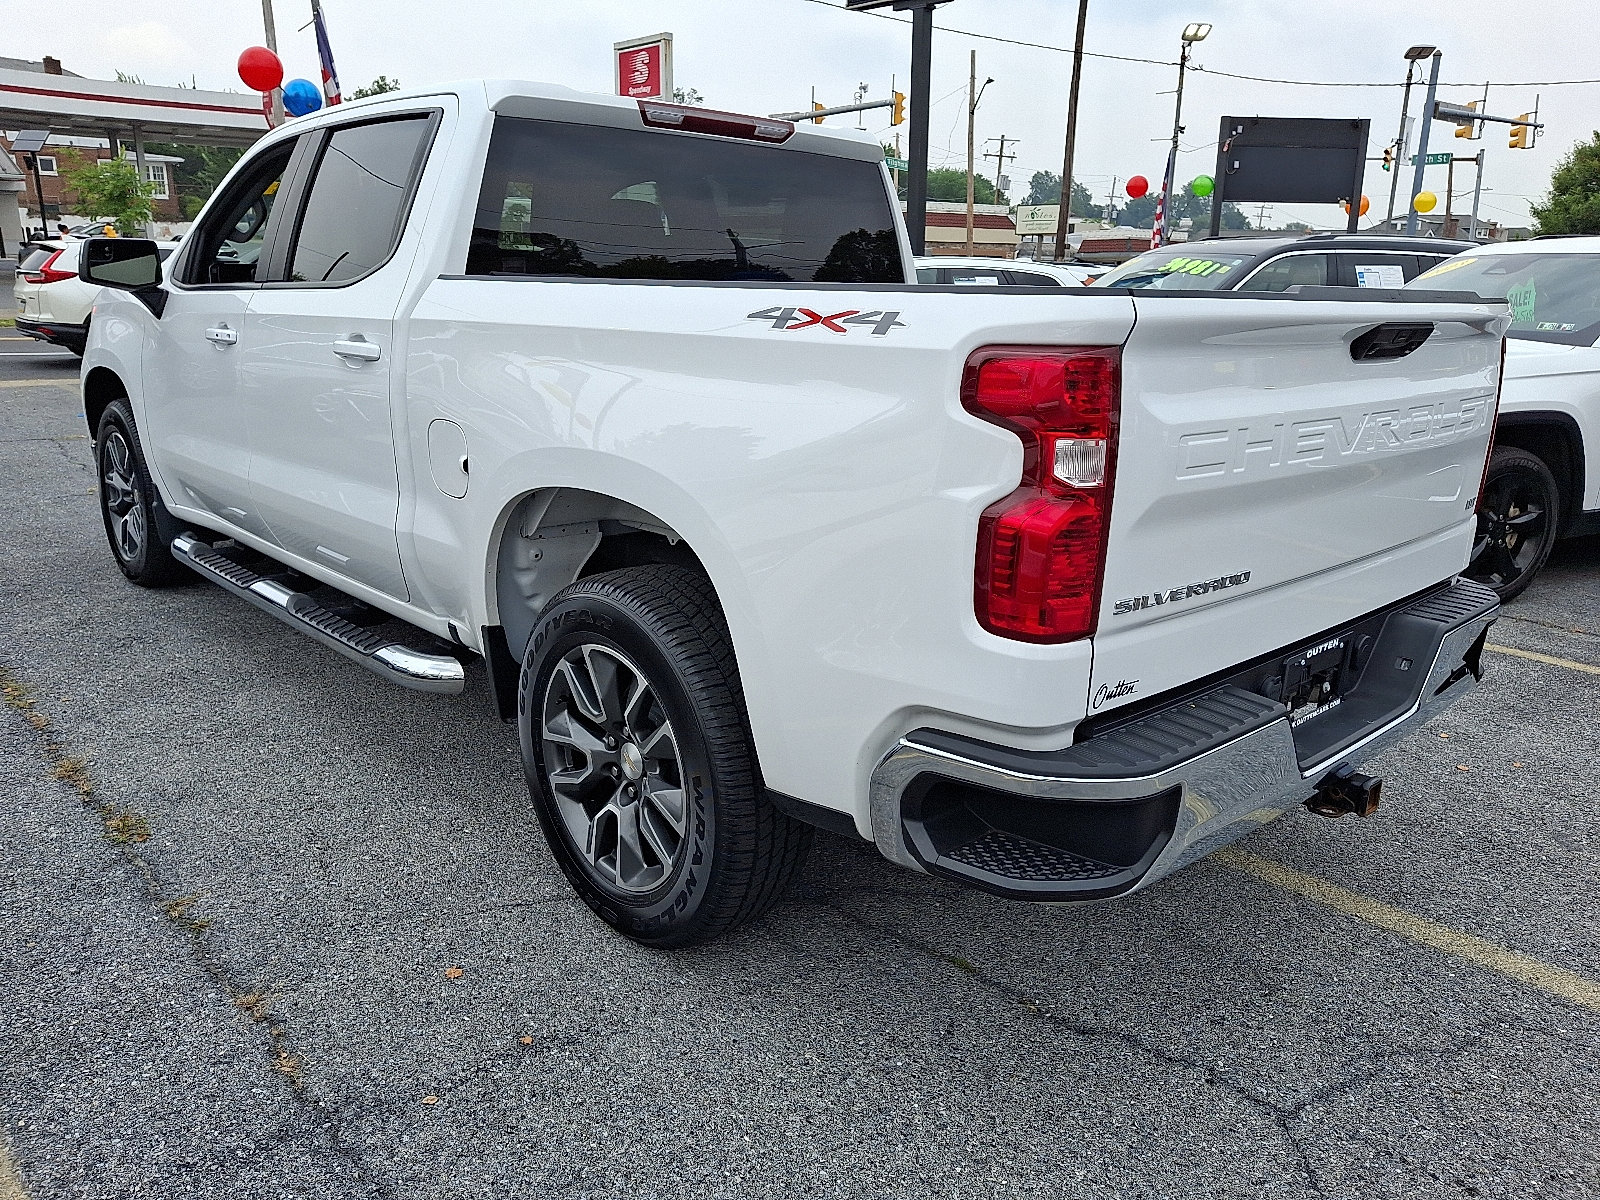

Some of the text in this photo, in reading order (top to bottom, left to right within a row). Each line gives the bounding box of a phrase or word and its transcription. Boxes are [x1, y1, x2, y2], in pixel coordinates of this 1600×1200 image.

[628, 85, 652, 97] Speedway
[1437, 154, 1448, 163] St
[1176, 393, 1495, 480] CHEVROLET
[1112, 569, 1252, 616] SILVERADO
[518, 608, 614, 717] GOODYEAR
[1306, 637, 1339, 659] OUTTEN
[1092, 679, 1140, 710] Outten
